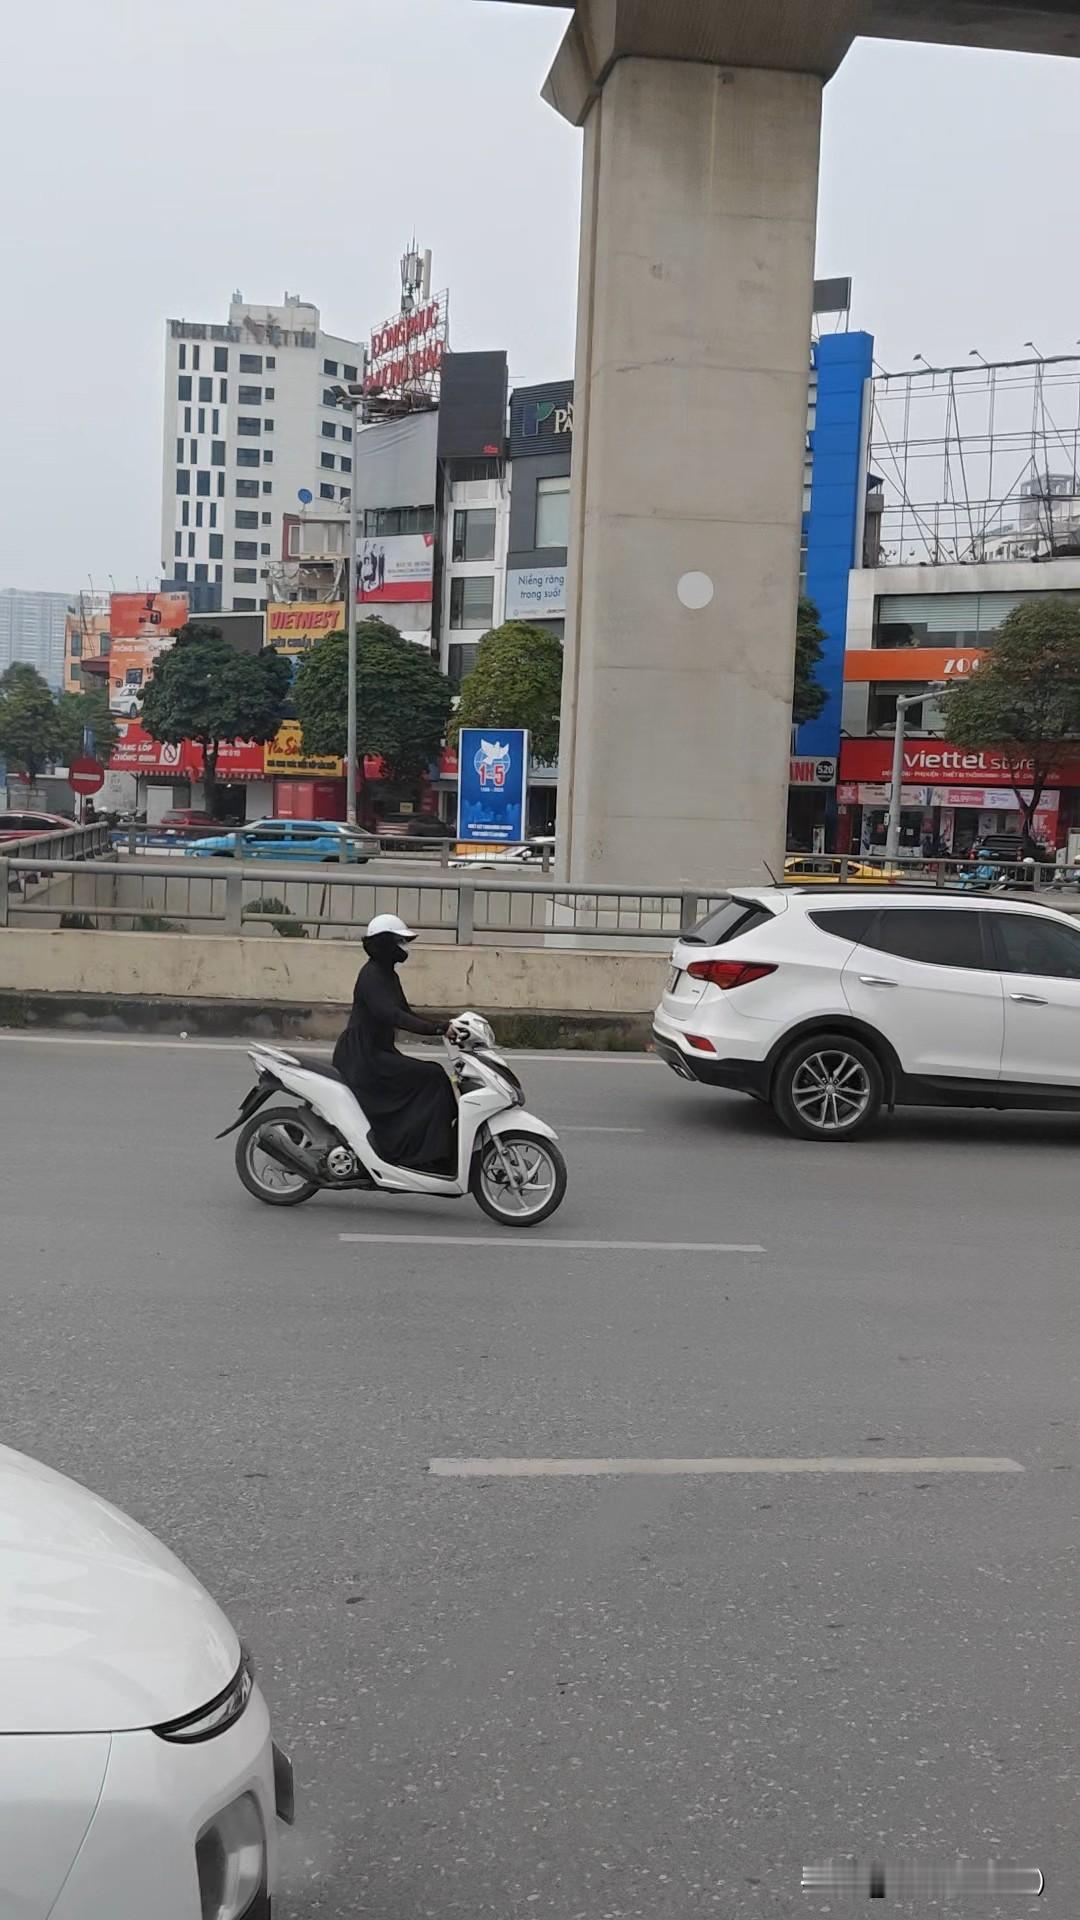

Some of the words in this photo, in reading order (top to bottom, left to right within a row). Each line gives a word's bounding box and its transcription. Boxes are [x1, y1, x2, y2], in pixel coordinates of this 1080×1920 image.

[271, 610, 340, 630] VIETNEST
[817, 764, 834, 775] 520
[904, 750, 987, 770] viettel
[479, 764, 505, 787] 1-5
